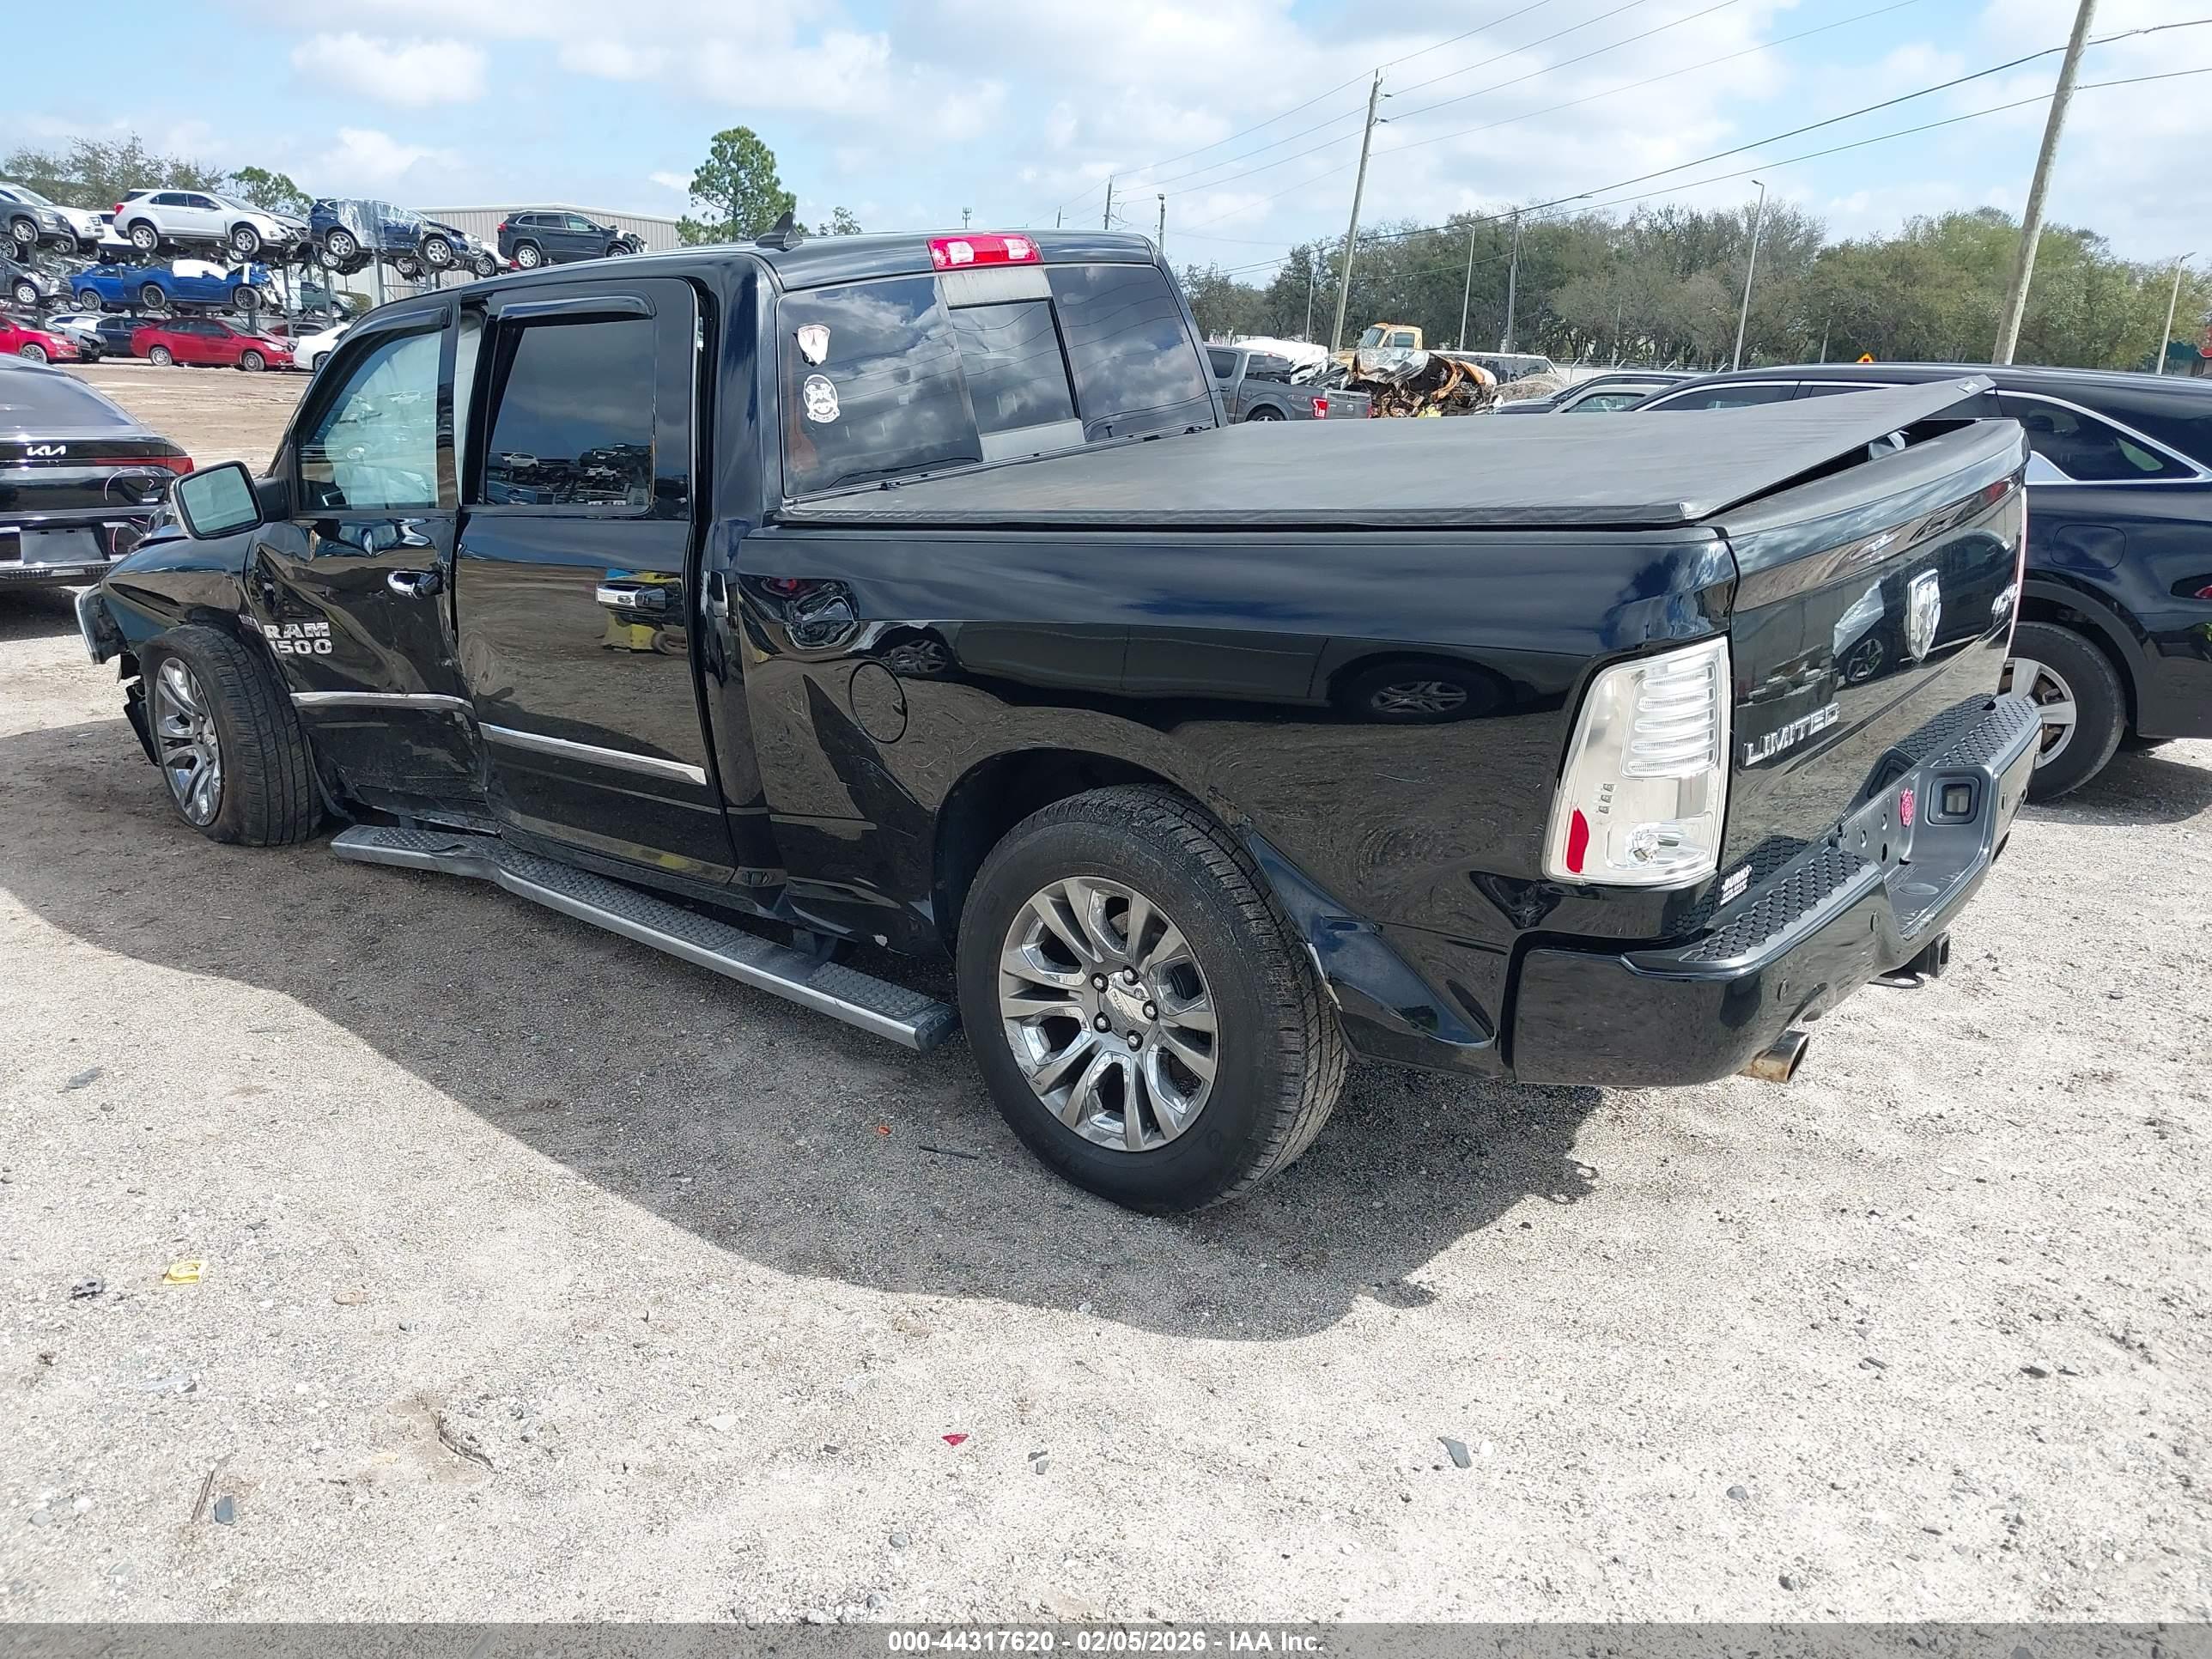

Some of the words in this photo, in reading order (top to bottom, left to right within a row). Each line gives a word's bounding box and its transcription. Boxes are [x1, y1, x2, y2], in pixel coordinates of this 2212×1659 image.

[27, 445, 66, 456] KIA
[263, 622, 331, 639] RAM
[269, 638, 333, 655] 1500
[1743, 702, 1841, 767] LIMITED
